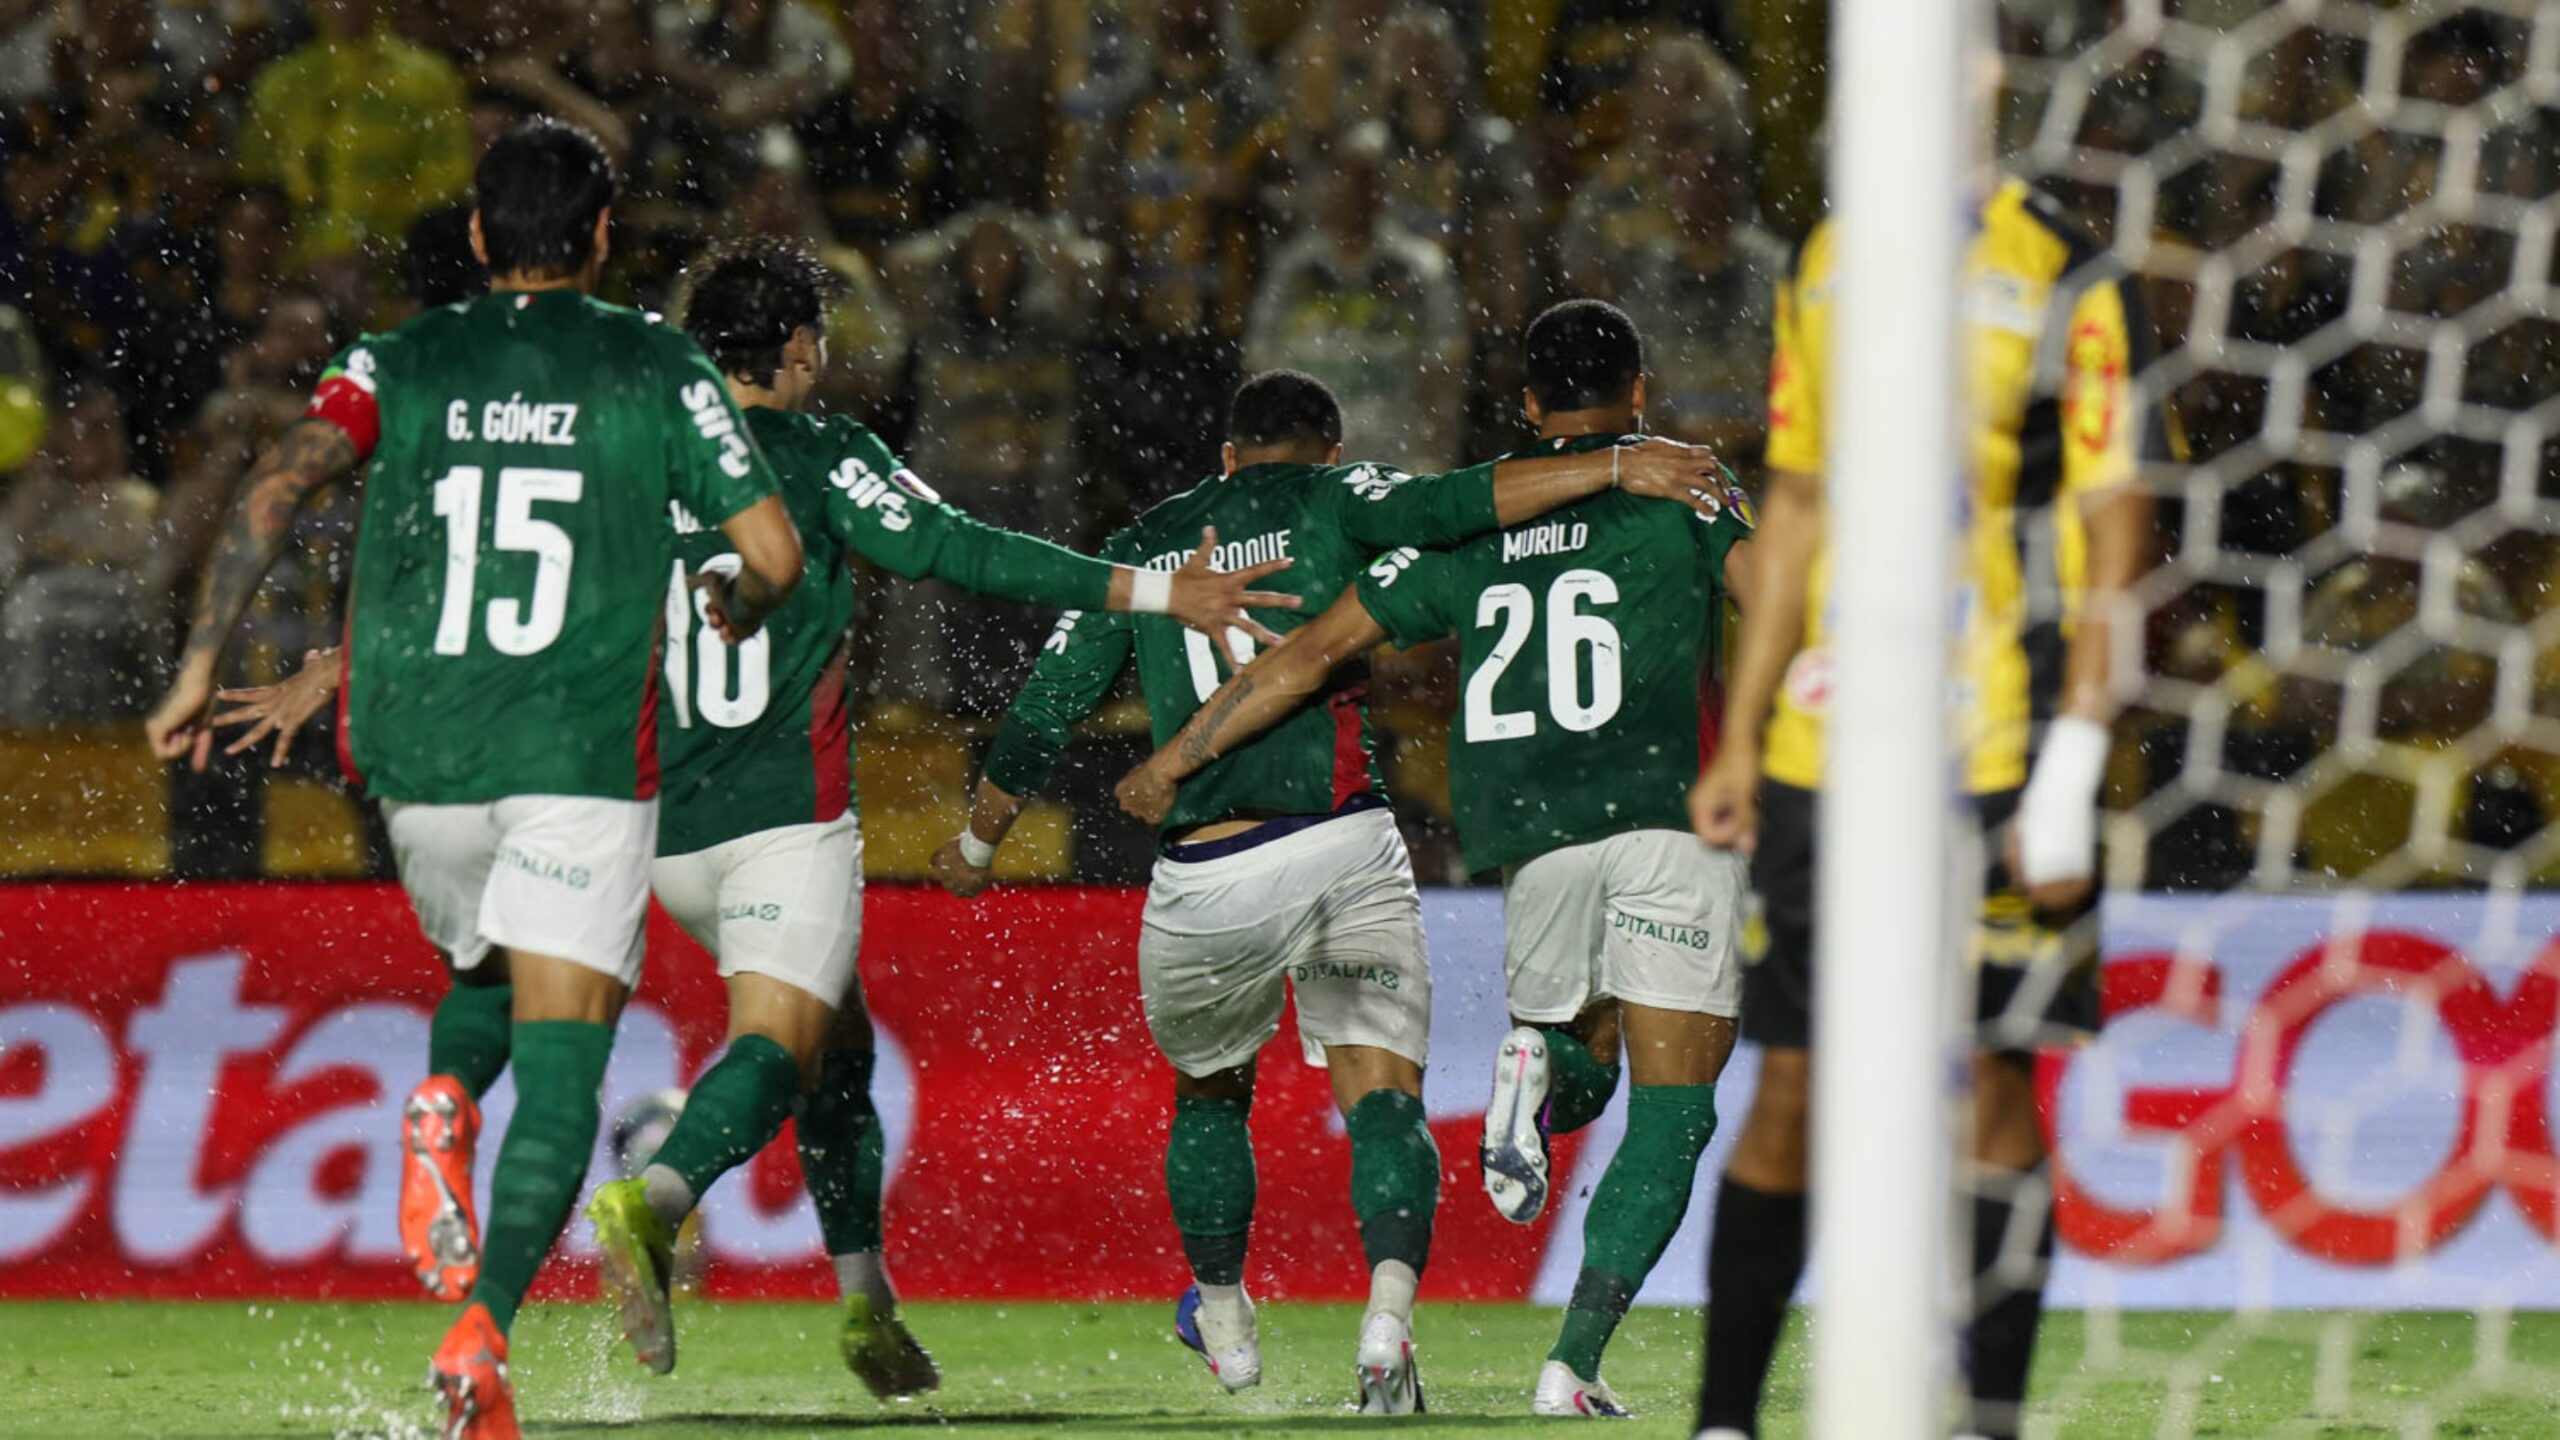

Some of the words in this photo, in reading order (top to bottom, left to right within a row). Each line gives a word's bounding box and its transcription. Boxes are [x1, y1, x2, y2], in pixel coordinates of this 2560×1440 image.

[447, 398, 474, 441] G.
[482, 391, 578, 446] GÓMEZ
[433, 465, 584, 657] 15
[1502, 521, 1589, 564] MURILO
[1463, 568, 1623, 744] 26
[1615, 910, 1689, 946] D'ITALIA
[2033, 927, 2560, 1268] GO
